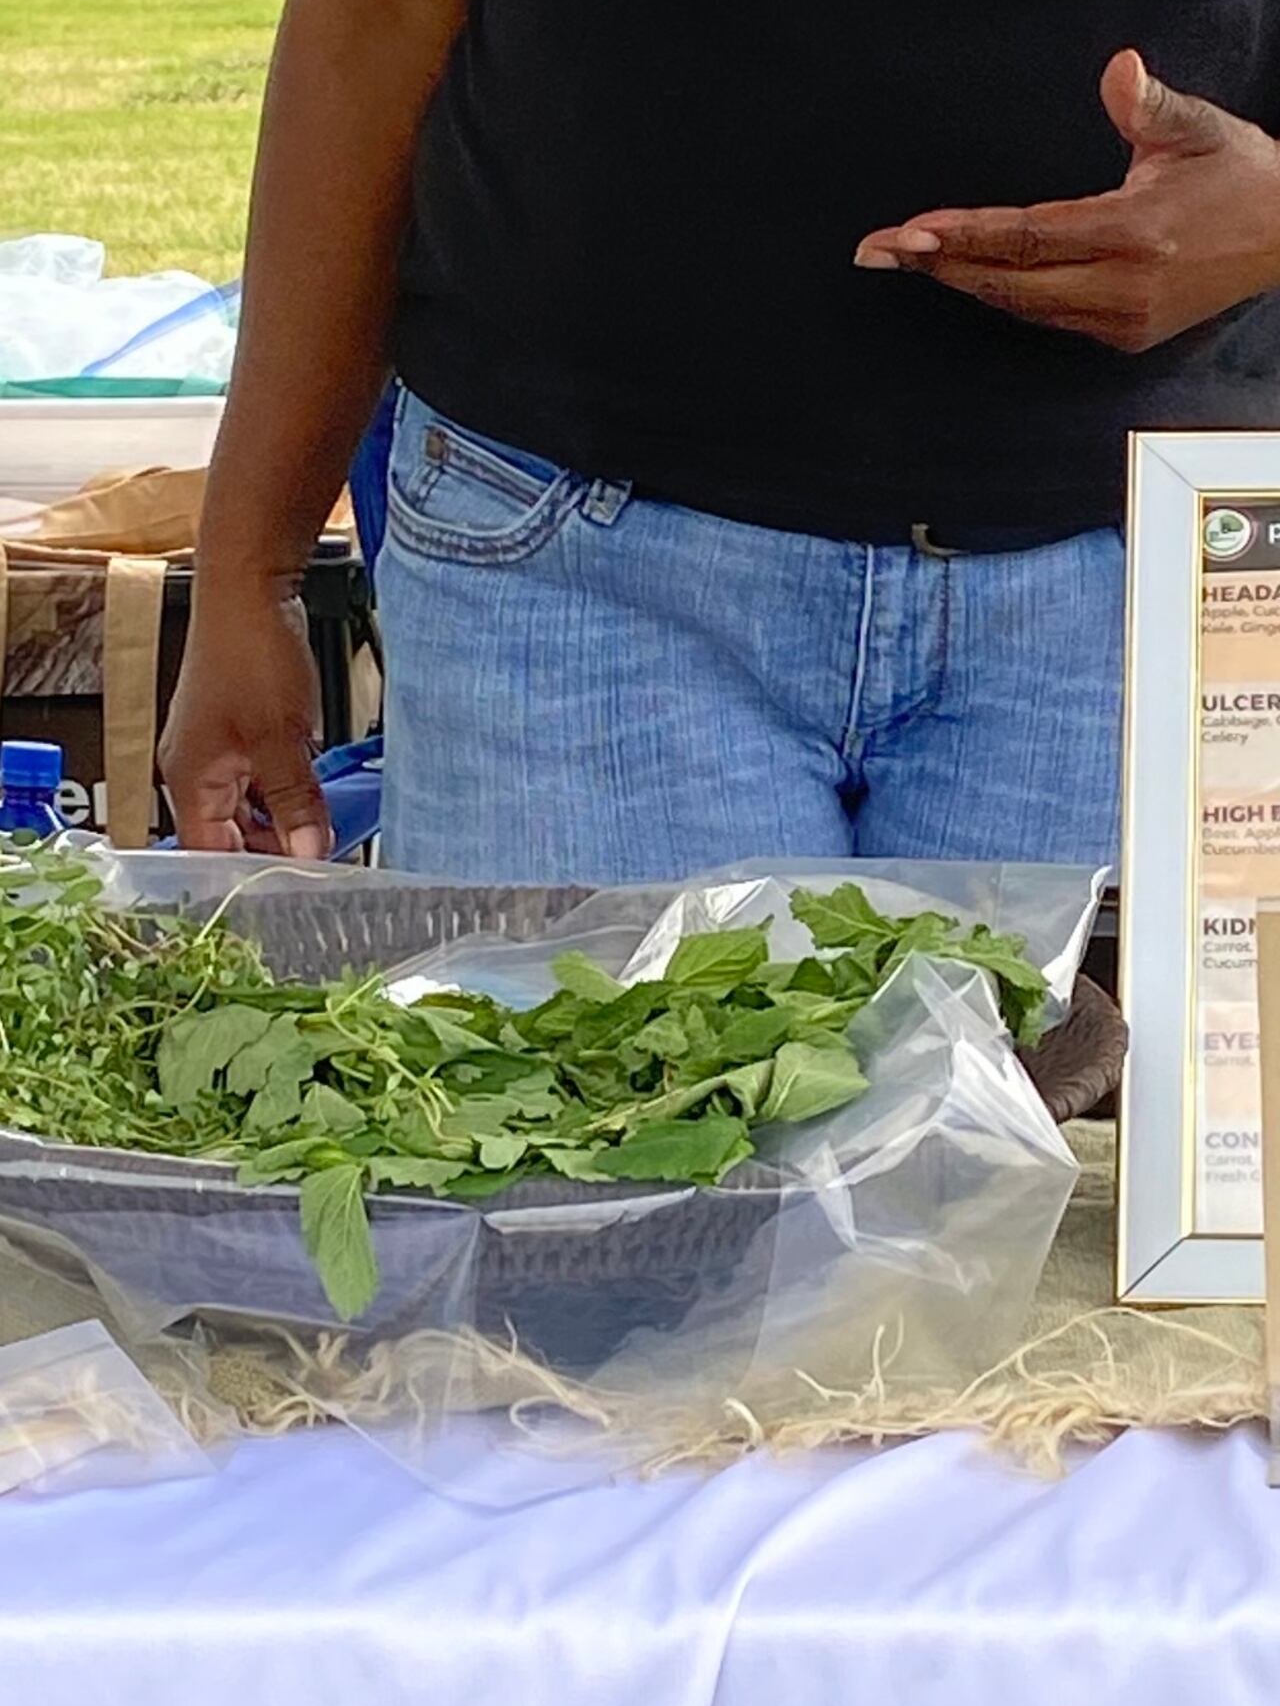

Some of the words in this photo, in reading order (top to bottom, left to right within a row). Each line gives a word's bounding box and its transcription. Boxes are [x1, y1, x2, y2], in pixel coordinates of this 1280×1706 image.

[1201, 731, 1249, 746] Celery
[1202, 804, 1264, 823] HIGH
[1203, 957, 1258, 970] Cucum
[1204, 1032, 1259, 1051] EYE
[1205, 1132, 1259, 1150] CON
